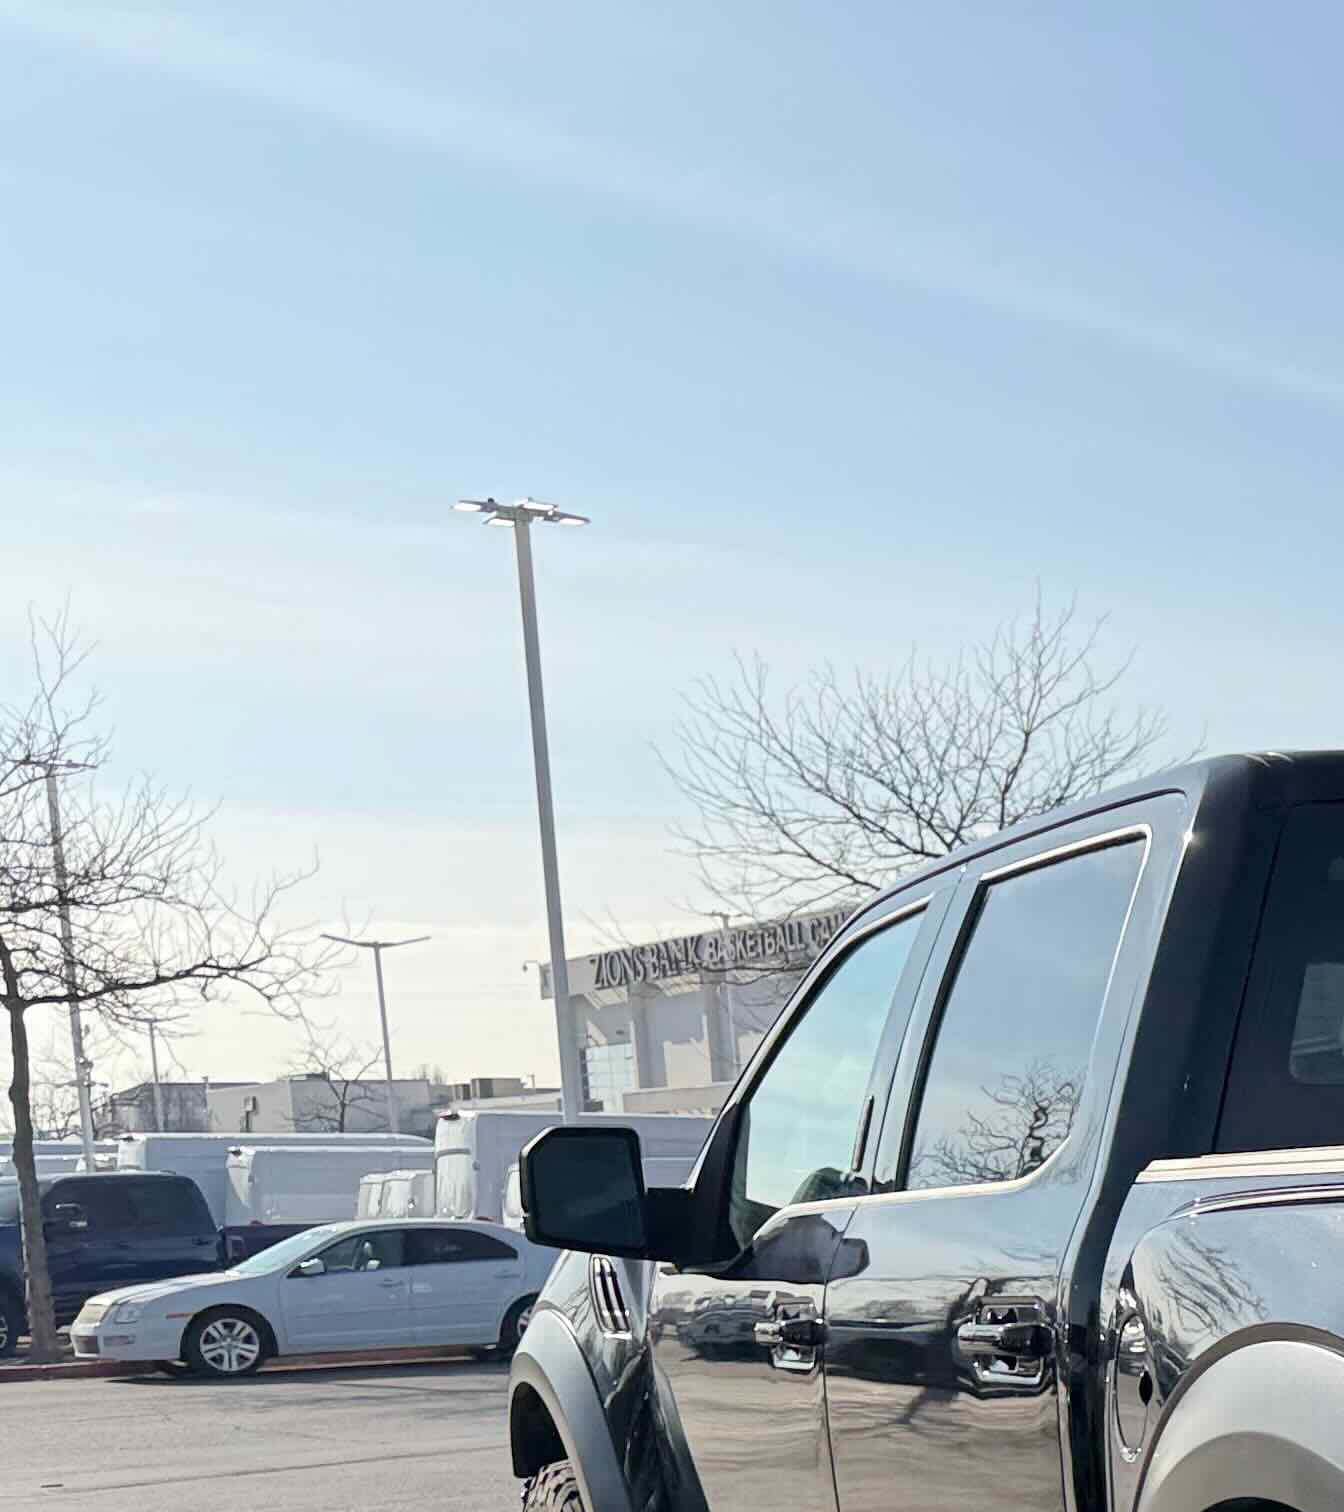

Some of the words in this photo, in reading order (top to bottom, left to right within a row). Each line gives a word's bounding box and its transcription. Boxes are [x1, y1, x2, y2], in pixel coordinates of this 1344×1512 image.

[589, 945, 649, 990] ZIONS
[649, 933, 702, 981] BANK
[705, 918, 807, 964] BASKETBALL
